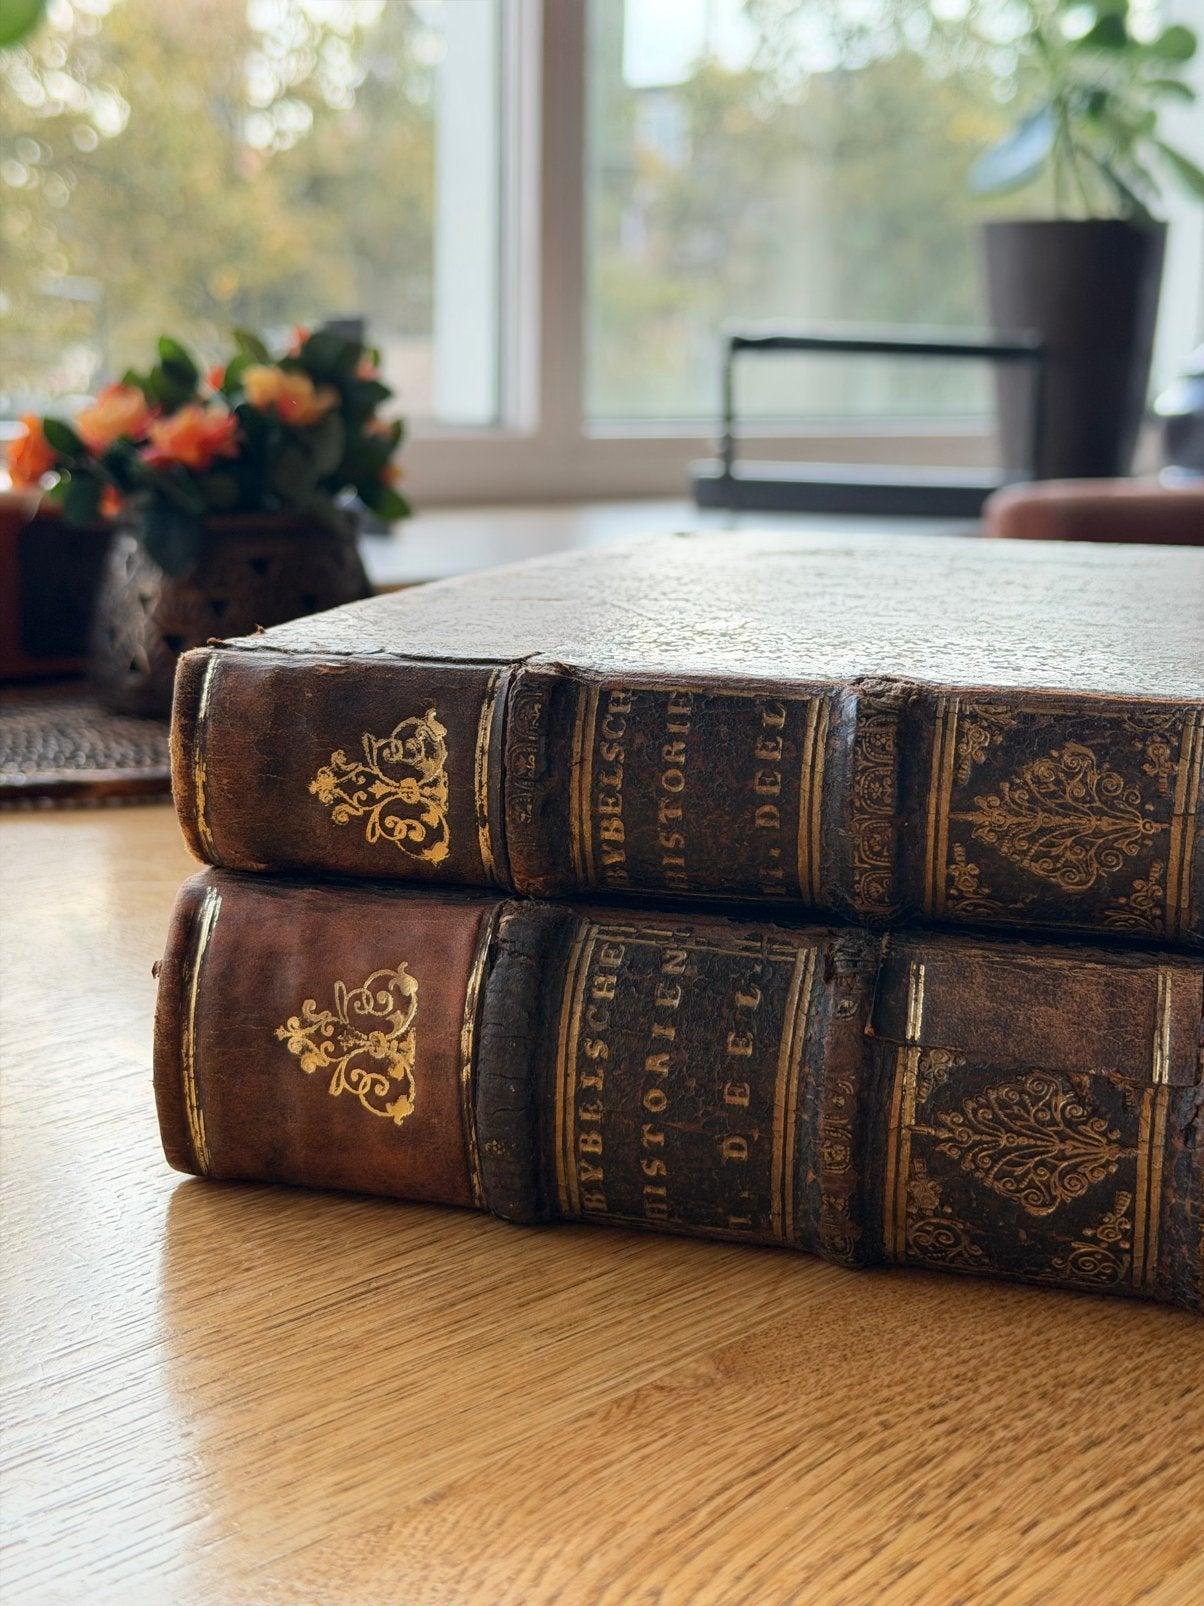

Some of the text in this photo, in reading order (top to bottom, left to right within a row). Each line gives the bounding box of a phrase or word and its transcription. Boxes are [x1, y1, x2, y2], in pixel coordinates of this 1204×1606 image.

[657, 690, 694, 889] HISTORIE
[579, 944, 625, 1211] BYBELSCHE
[641, 949, 688, 1218] HISTORIEN
